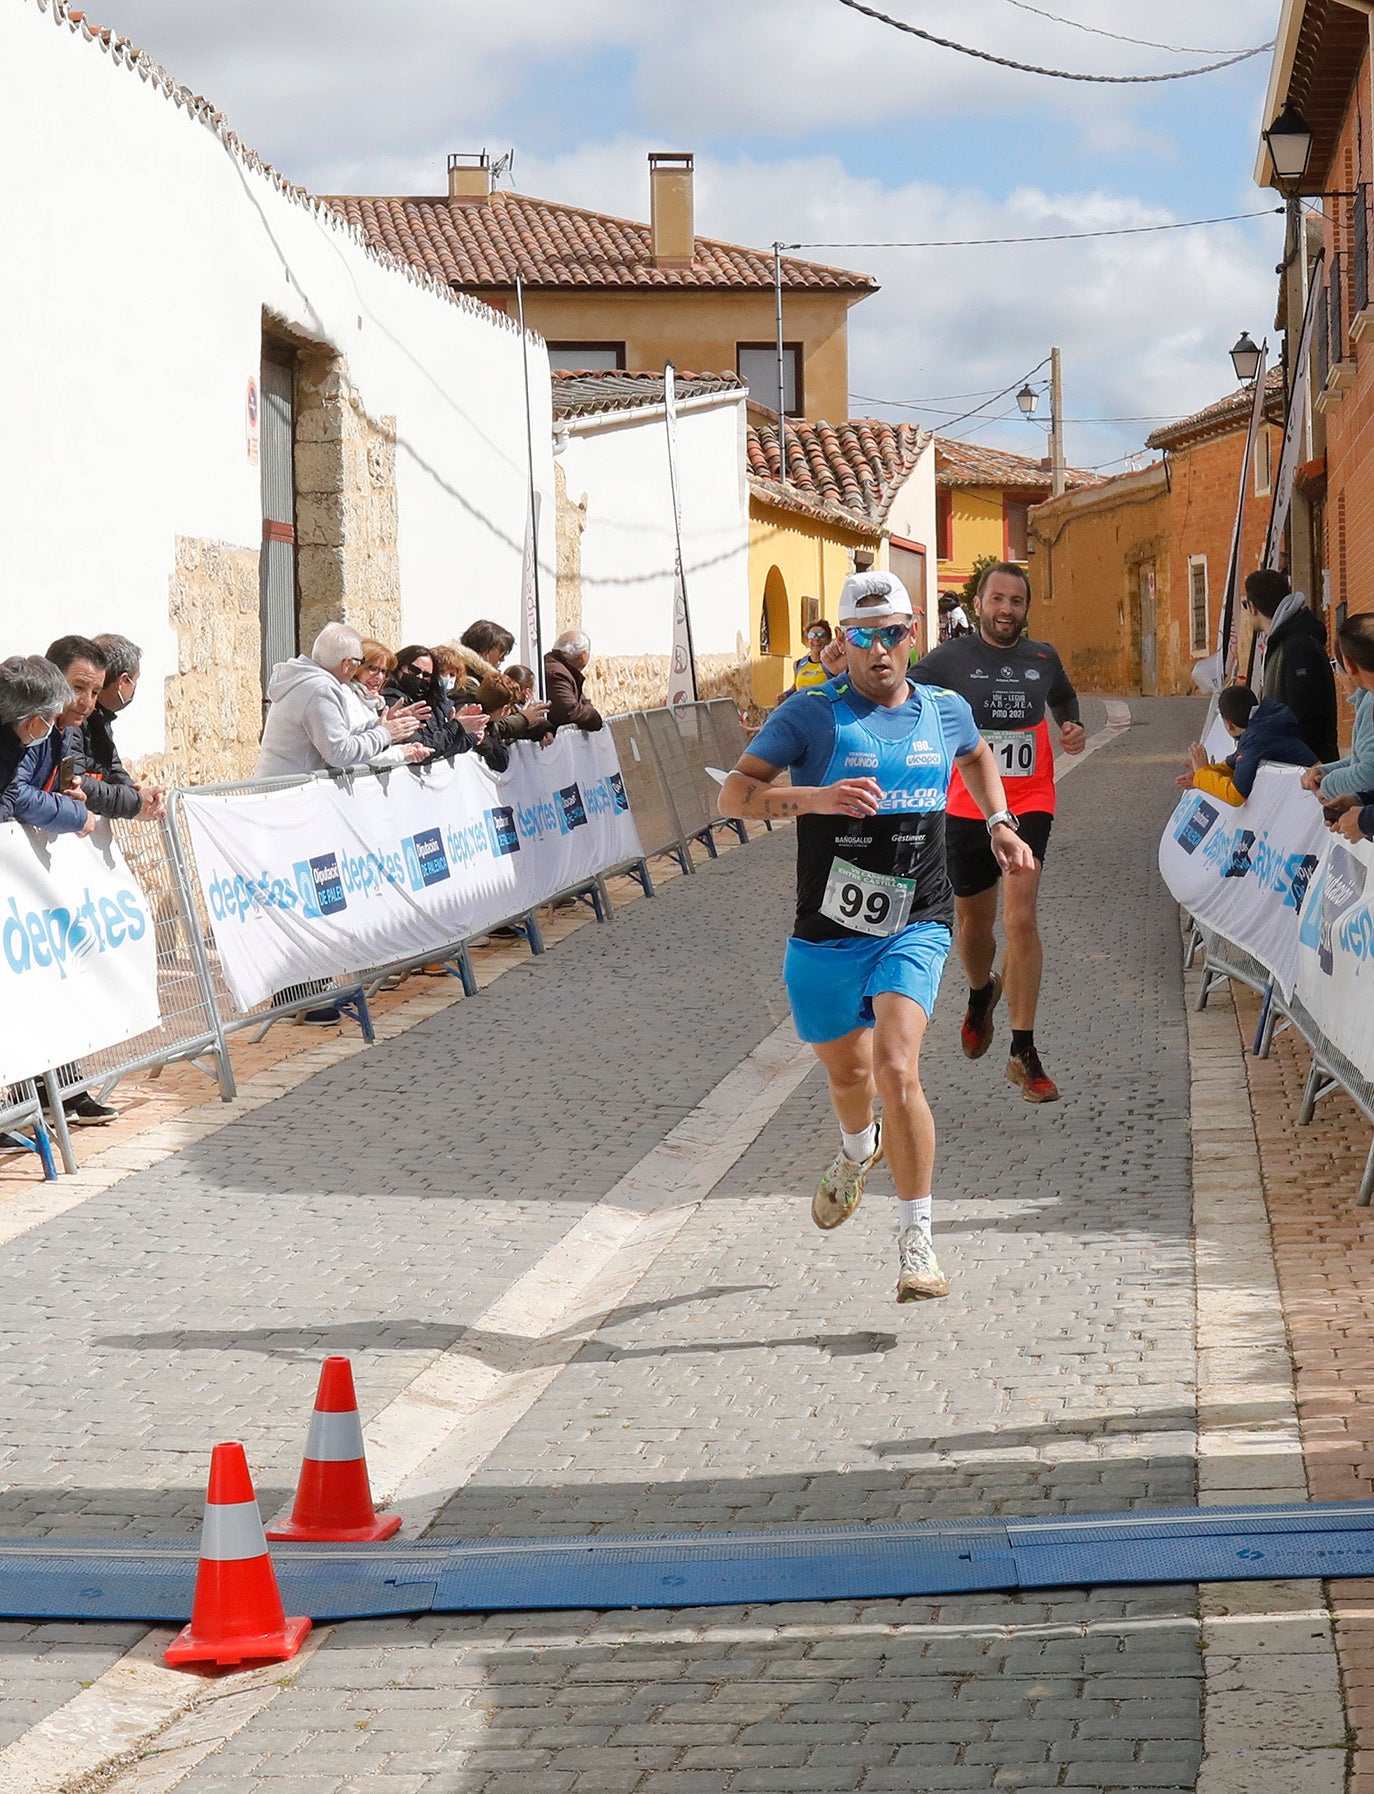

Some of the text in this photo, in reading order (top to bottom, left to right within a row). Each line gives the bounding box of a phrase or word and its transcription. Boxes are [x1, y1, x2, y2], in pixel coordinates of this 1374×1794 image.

[992, 710, 1025, 719] PMD 2021
[844, 757, 879, 768] MUNDO
[835, 835, 873, 844] BAÑOSALUD
[838, 867, 908, 890] ENTRE CASTILLOS
[839, 883, 891, 925] 99
[3, 887, 146, 980] deportes
